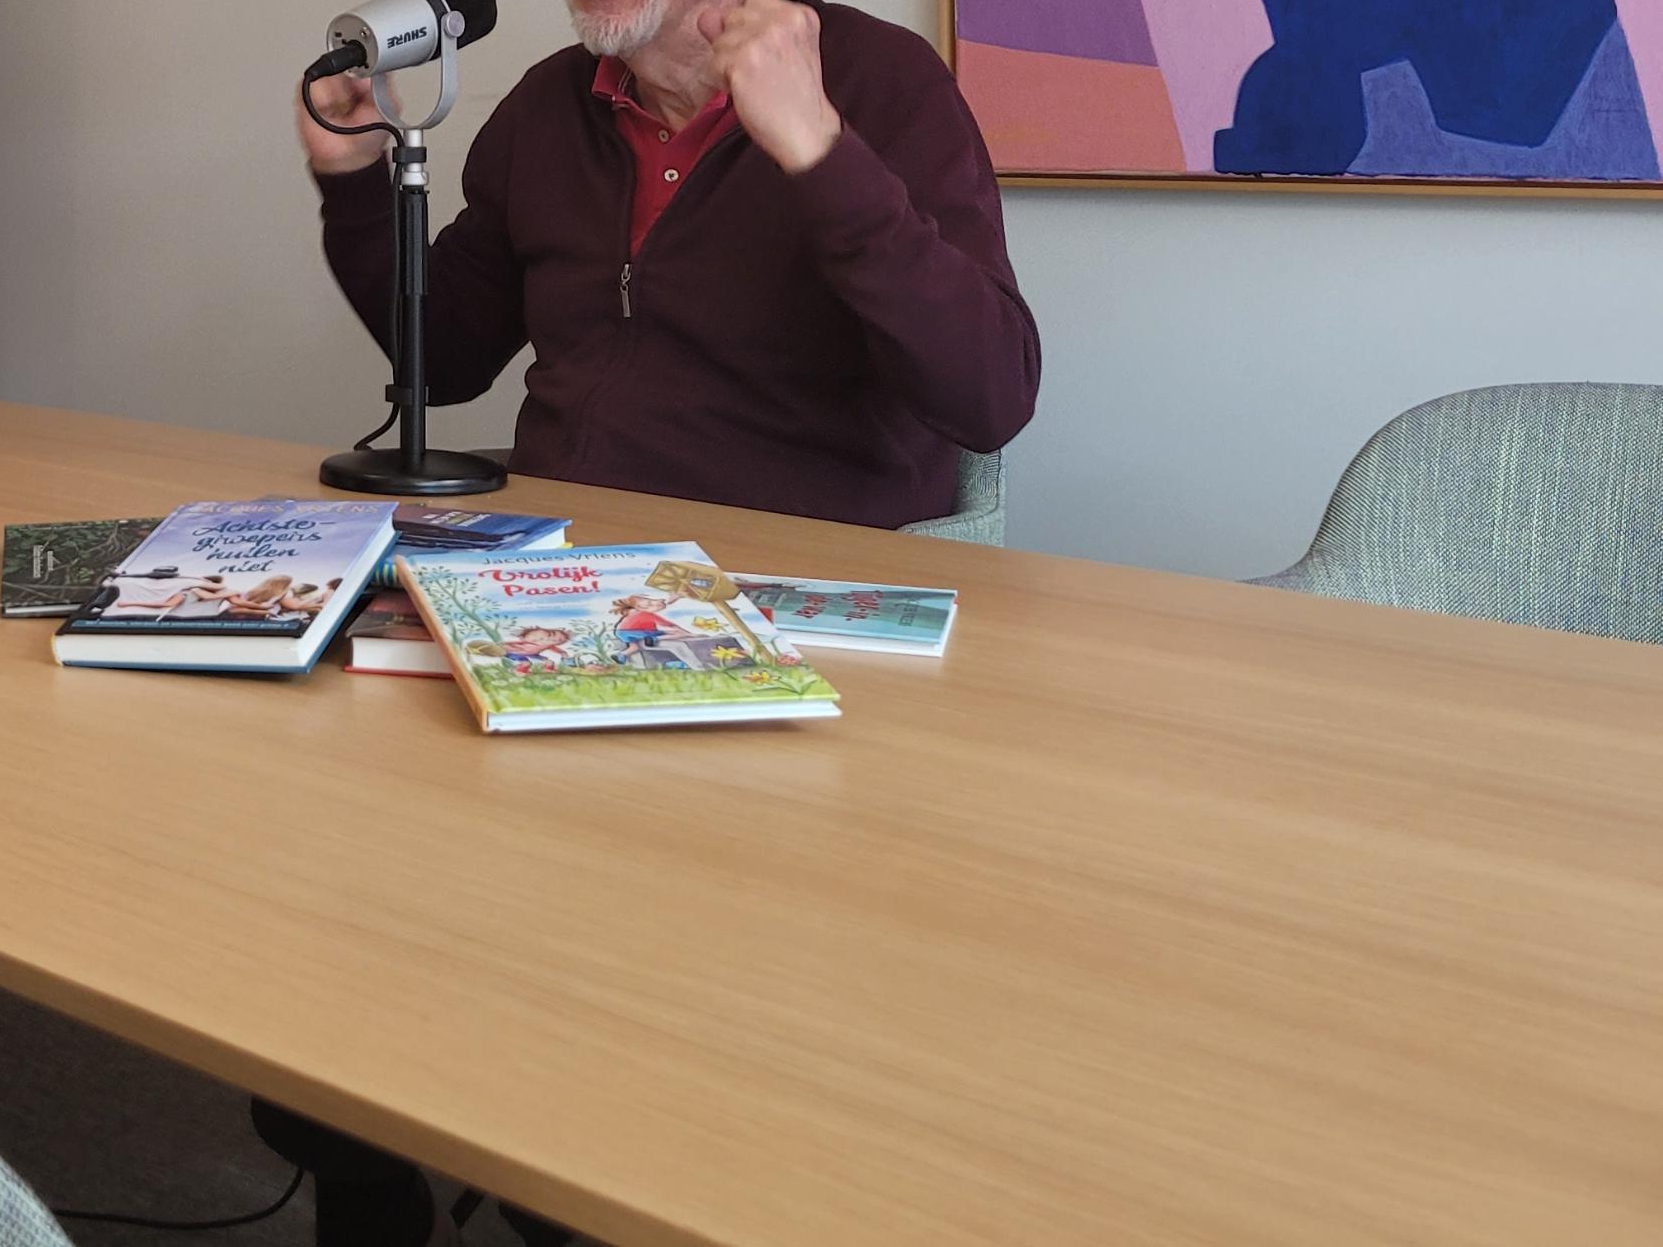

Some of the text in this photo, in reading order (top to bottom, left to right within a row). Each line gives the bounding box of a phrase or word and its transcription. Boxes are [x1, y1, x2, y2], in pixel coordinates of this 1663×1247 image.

[387, 26, 427, 48] SHURE
[206, 544, 300, 560] huilen
[483, 552, 636, 565] Jacques Vriens
[218, 560, 274, 573] niet
[478, 566, 603, 582] Vrolijk
[503, 581, 601, 597] Pasen!
